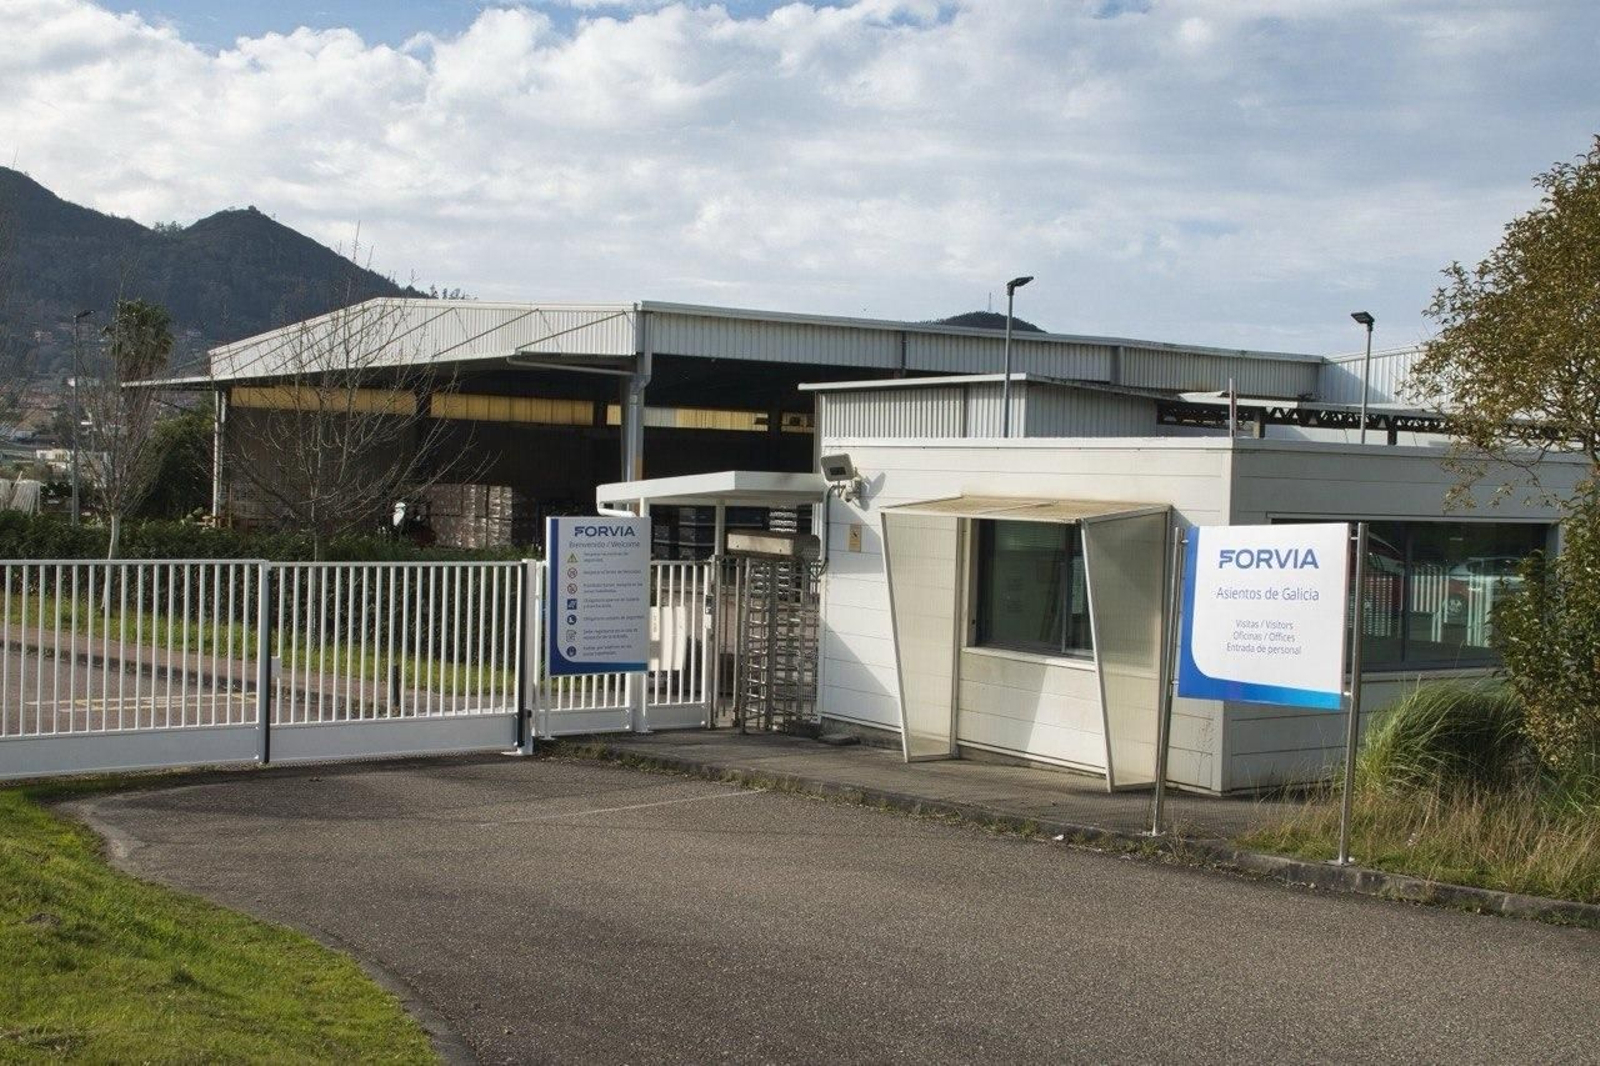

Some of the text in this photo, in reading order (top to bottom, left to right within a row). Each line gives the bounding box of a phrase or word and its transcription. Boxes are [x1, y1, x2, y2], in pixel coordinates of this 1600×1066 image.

[574, 526, 636, 537] FORVIA
[610, 540, 640, 548] Welcome
[1219, 548, 1319, 569] FORVIA
[1216, 587, 1319, 601] Asientos de Galicia
[1235, 619, 1259, 629] Visitas
[1265, 619, 1294, 630] Visitors
[1233, 631, 1262, 641] Oficinas
[1269, 632, 1295, 642] Offices
[1226, 642, 1301, 656] Entrada de personal
